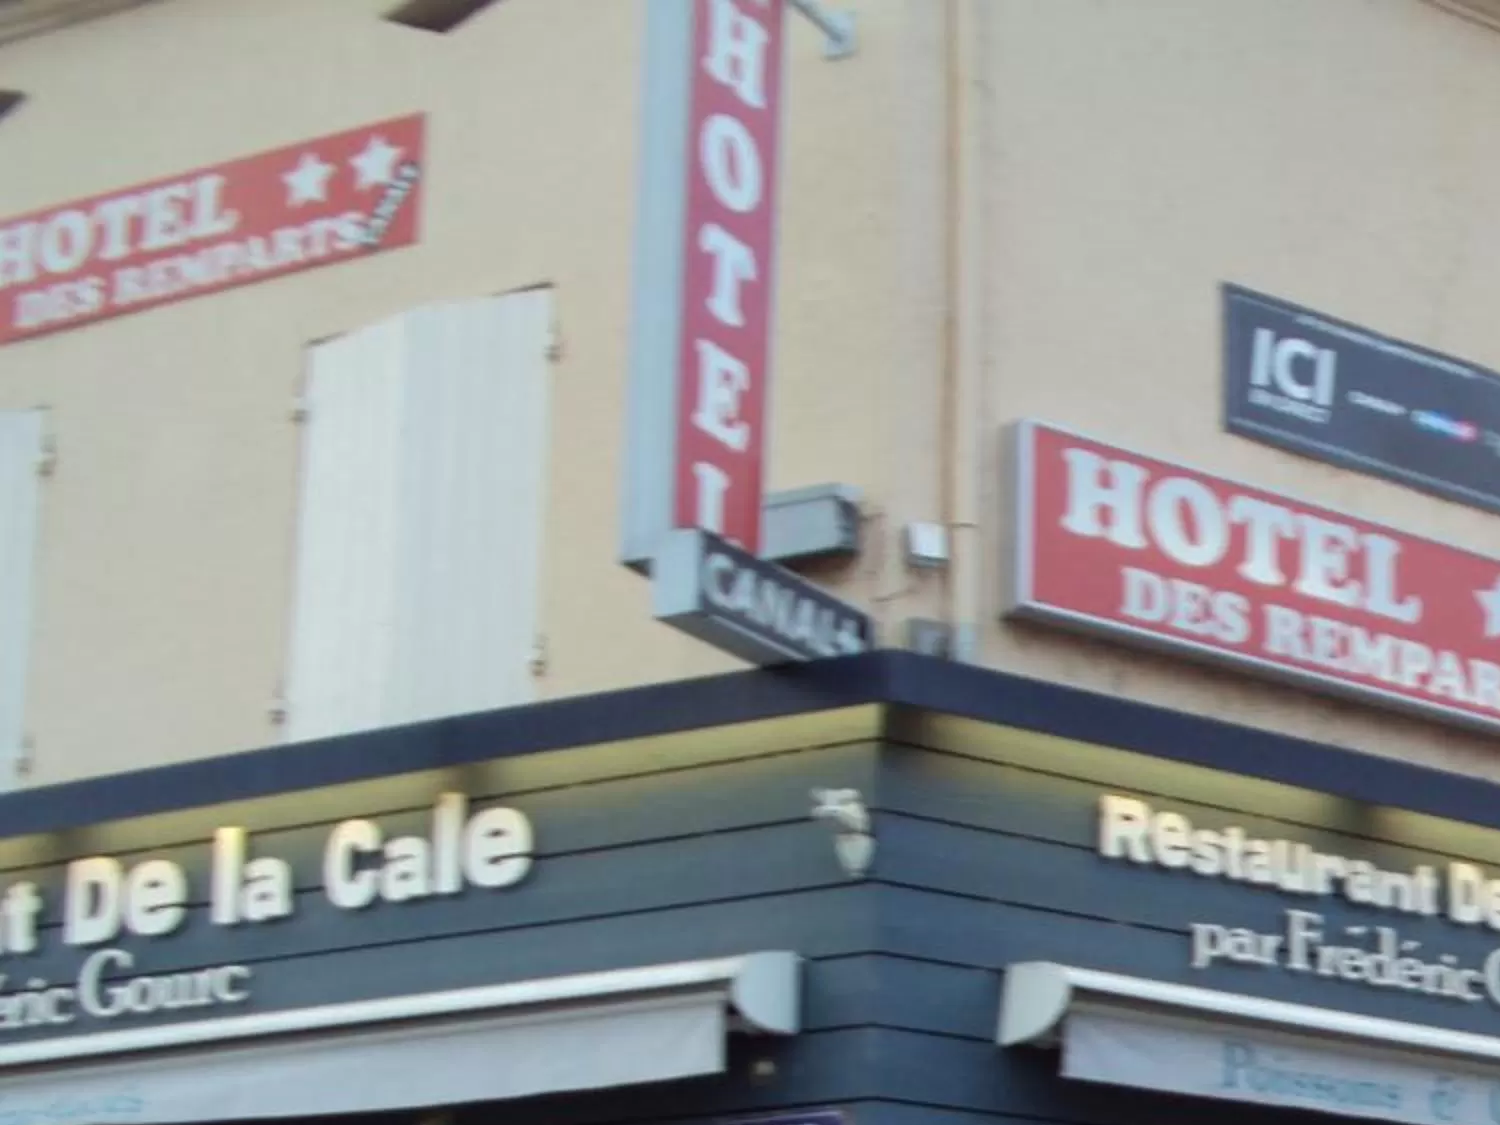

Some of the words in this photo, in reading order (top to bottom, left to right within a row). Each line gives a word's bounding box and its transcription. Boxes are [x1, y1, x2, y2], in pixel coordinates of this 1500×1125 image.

[0, 174, 239, 289] HOTEL
[12, 277, 104, 328] DES
[113, 211, 376, 305] REMPARTS
[1249, 327, 1337, 406] ICI
[1060, 448, 1424, 623] HOTEL
[1121, 567, 1250, 644] DES
[64, 856, 188, 945] De
[209, 826, 293, 926] la
[322, 792, 534, 909] Cale
[1100, 794, 1441, 916] Restaurant
[1188, 920, 1284, 970] par
[1284, 908, 1487, 1001] Frédéric
